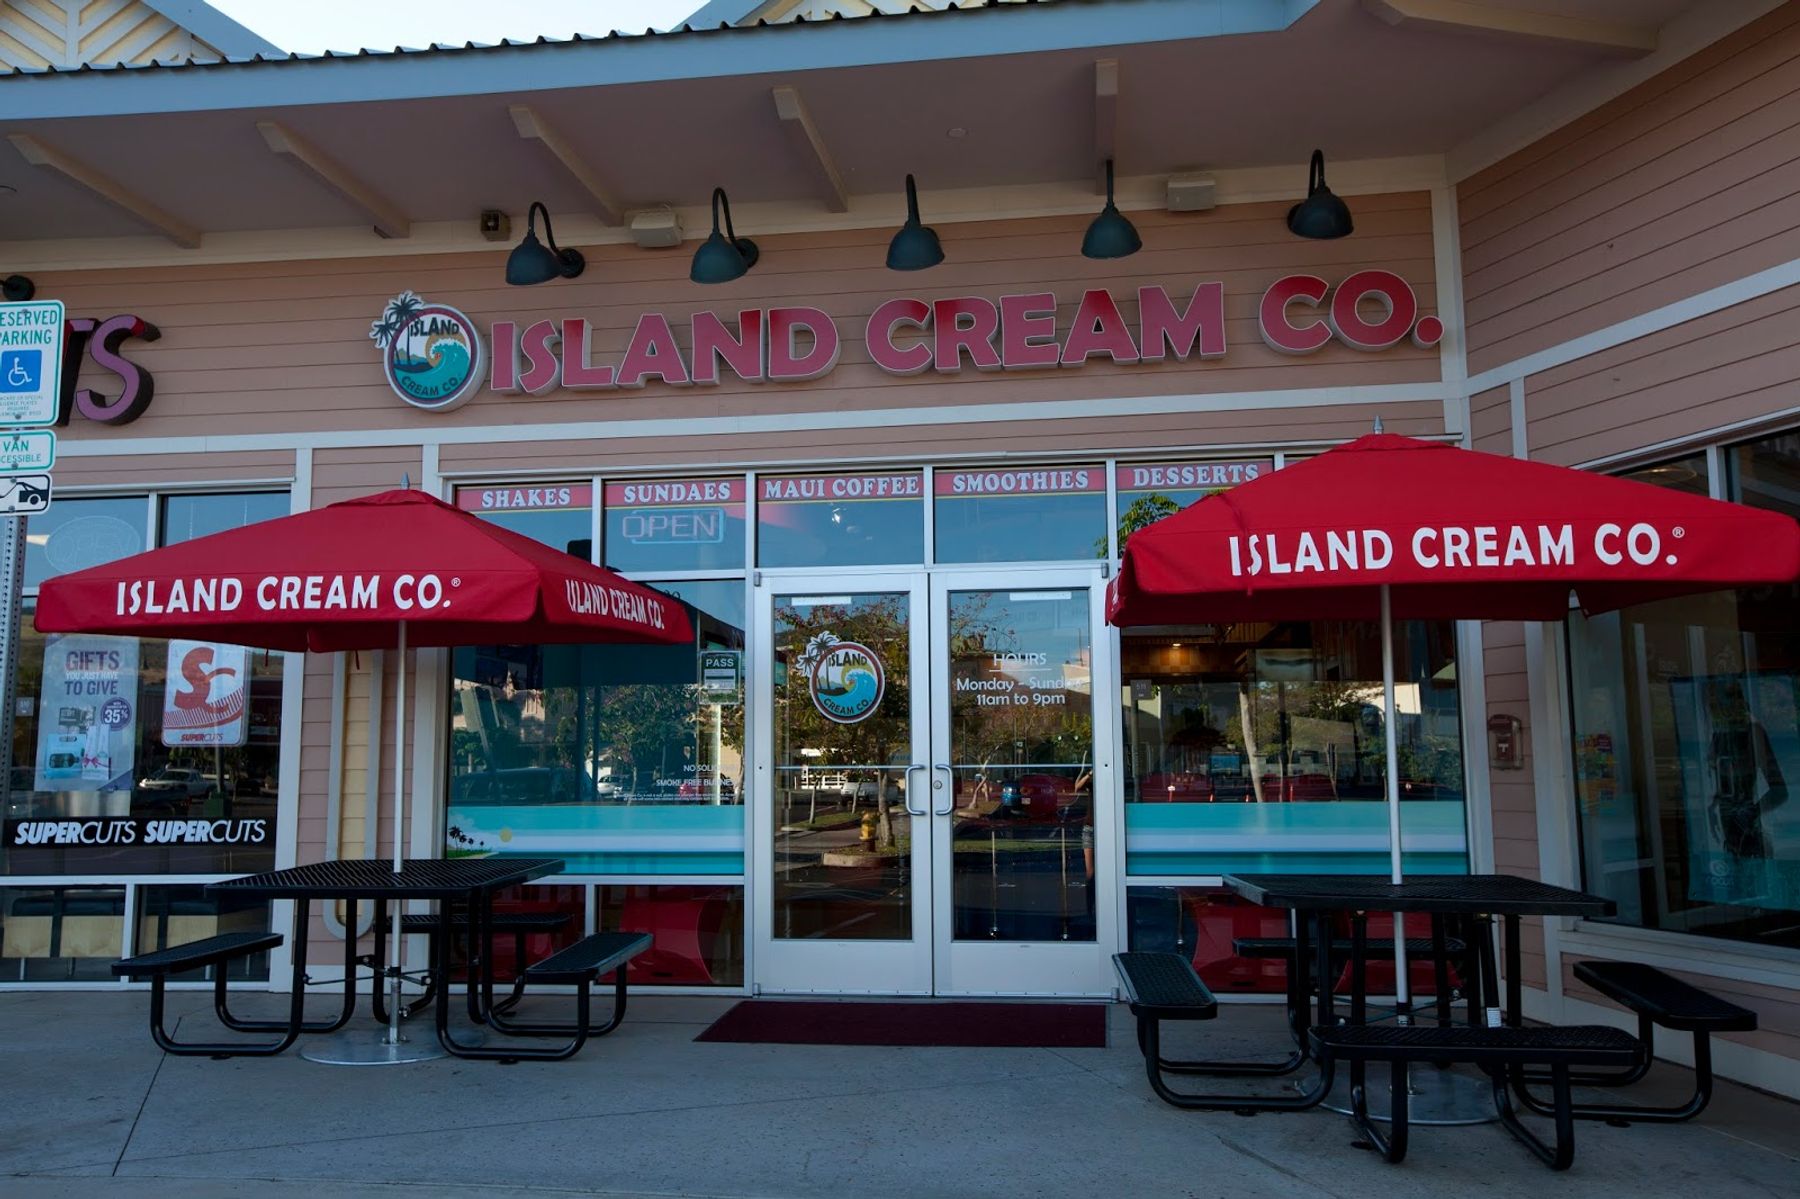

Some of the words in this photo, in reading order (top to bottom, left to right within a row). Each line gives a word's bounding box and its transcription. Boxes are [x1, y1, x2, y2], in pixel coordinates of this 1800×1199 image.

[0, 310, 58, 327] ESERVED
[410, 317, 460, 337] ISLAND
[491, 307, 838, 393] ISLAND
[865, 282, 1226, 371] CREAM
[1259, 270, 1444, 351] CO.
[402, 376, 439, 396] CREAM
[3, 441, 29, 452] VAN
[0, 454, 42, 464] CESSIBLE
[953, 470, 1089, 493] SMOOTHIES
[1133, 464, 1259, 487] DESSERTS
[623, 482, 732, 504] SUNDAES
[764, 478, 825, 499] MAUI
[832, 476, 920, 497] COFFEE
[481, 488, 571, 508] SHAKES
[622, 512, 718, 540] OPEN
[1229, 529, 1394, 576] ISLAND
[1411, 524, 1575, 569] CREAM
[117, 578, 243, 615] ISLAND
[256, 575, 380, 610] CREAM
[566, 579, 609, 615] ISLAND
[609, 588, 648, 625] CREAM
[66, 650, 119, 671] GIFTS
[705, 658, 734, 668] PASS
[828, 652, 868, 667] ISLAND
[993, 652, 1047, 666] HOURS
[65, 671, 80, 680] YOU
[81, 671, 99, 680] JUST
[956, 678, 1015, 692] Monday
[64, 680, 83, 695] TO
[86, 680, 119, 695] GIVE
[823, 698, 855, 715] CREAM
[976, 694, 1010, 706] 11am
[1014, 693, 1029, 705] to
[1032, 693, 1066, 707] 9pm
[180, 733, 224, 742] SUPERCUTS
[683, 764, 696, 772] NO
[14, 821, 137, 844] SUPERCUTS
[143, 819, 266, 843] SUPERCUTS
